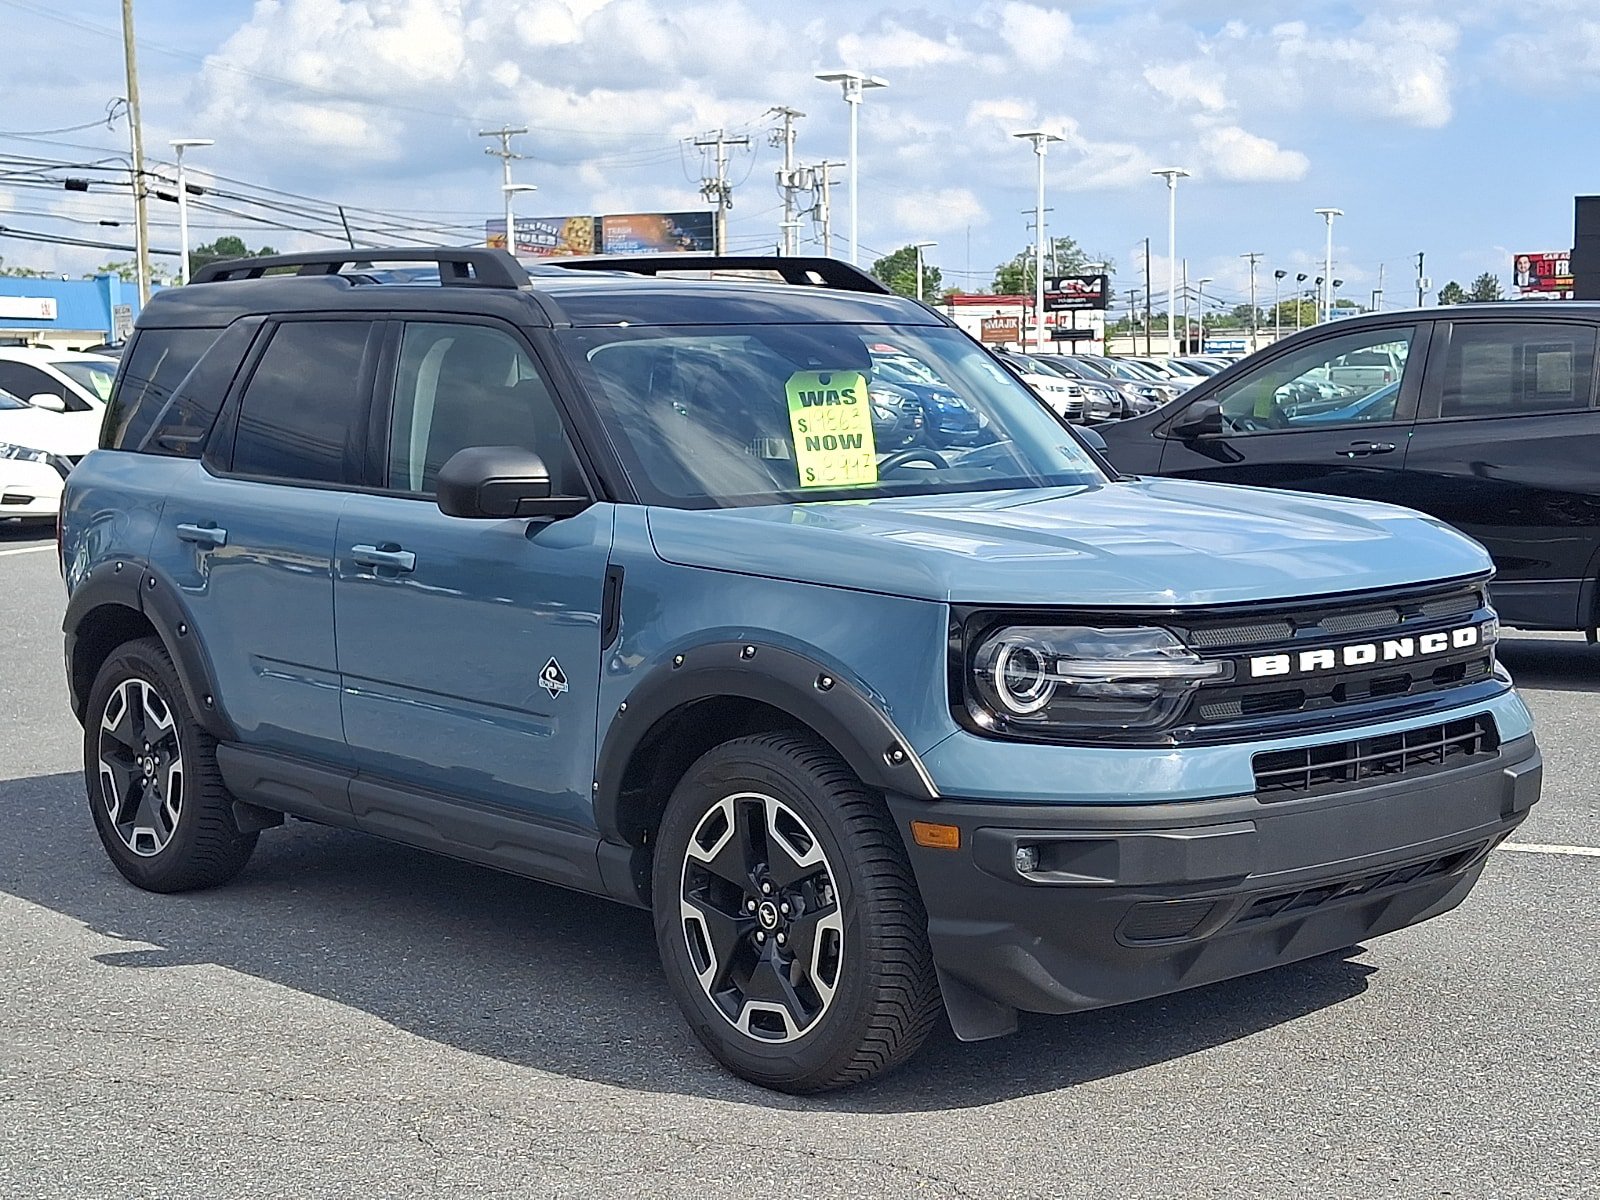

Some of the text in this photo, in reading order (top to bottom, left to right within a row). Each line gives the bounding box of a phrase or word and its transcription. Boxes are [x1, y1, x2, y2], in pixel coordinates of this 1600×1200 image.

[798, 388, 857, 407] WAS
[805, 433, 863, 451] NOW
[1250, 626, 1478, 678] BRONCO
